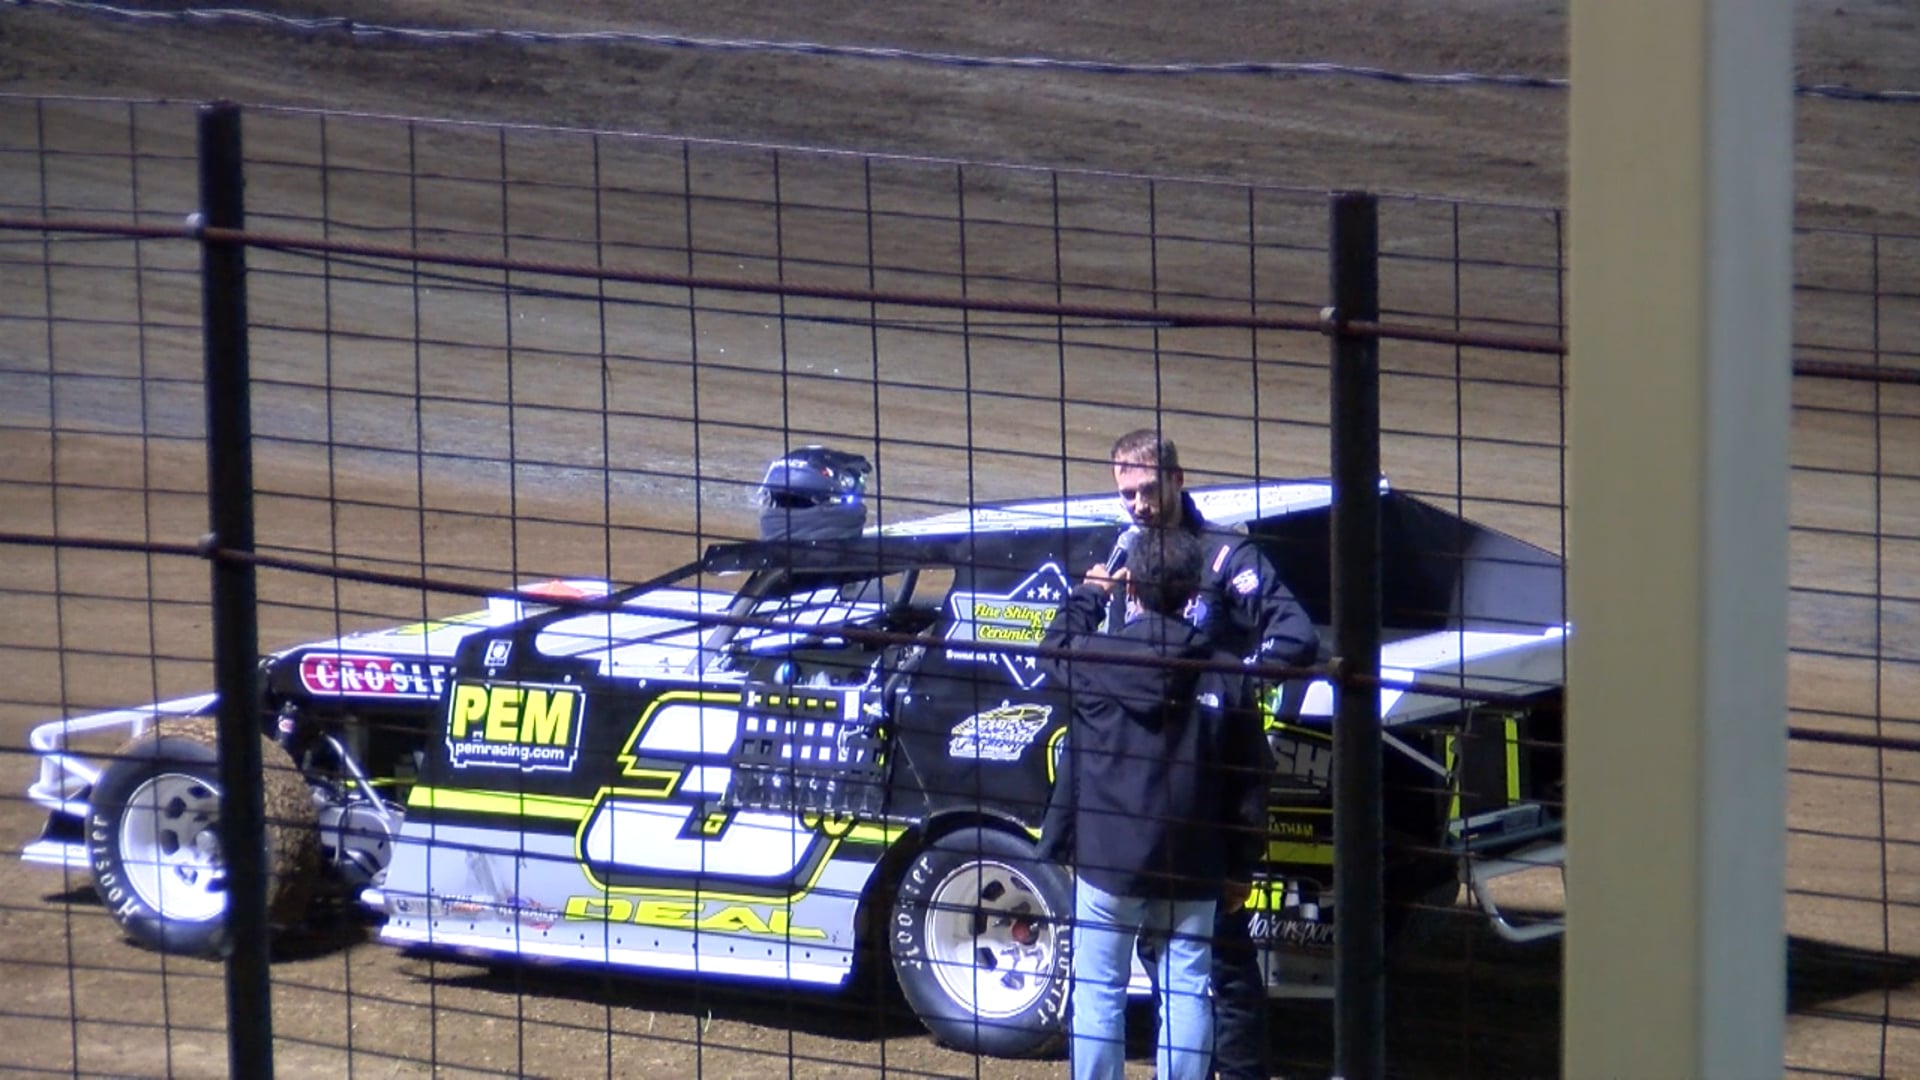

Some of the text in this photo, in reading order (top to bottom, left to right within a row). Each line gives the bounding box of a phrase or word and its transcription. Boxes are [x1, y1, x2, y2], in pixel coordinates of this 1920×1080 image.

[979, 625, 1033, 641] Ceramic
[452, 684, 574, 746] PEM
[455, 741, 565, 761] pemracing.com
[563, 896, 826, 939] DEAL
